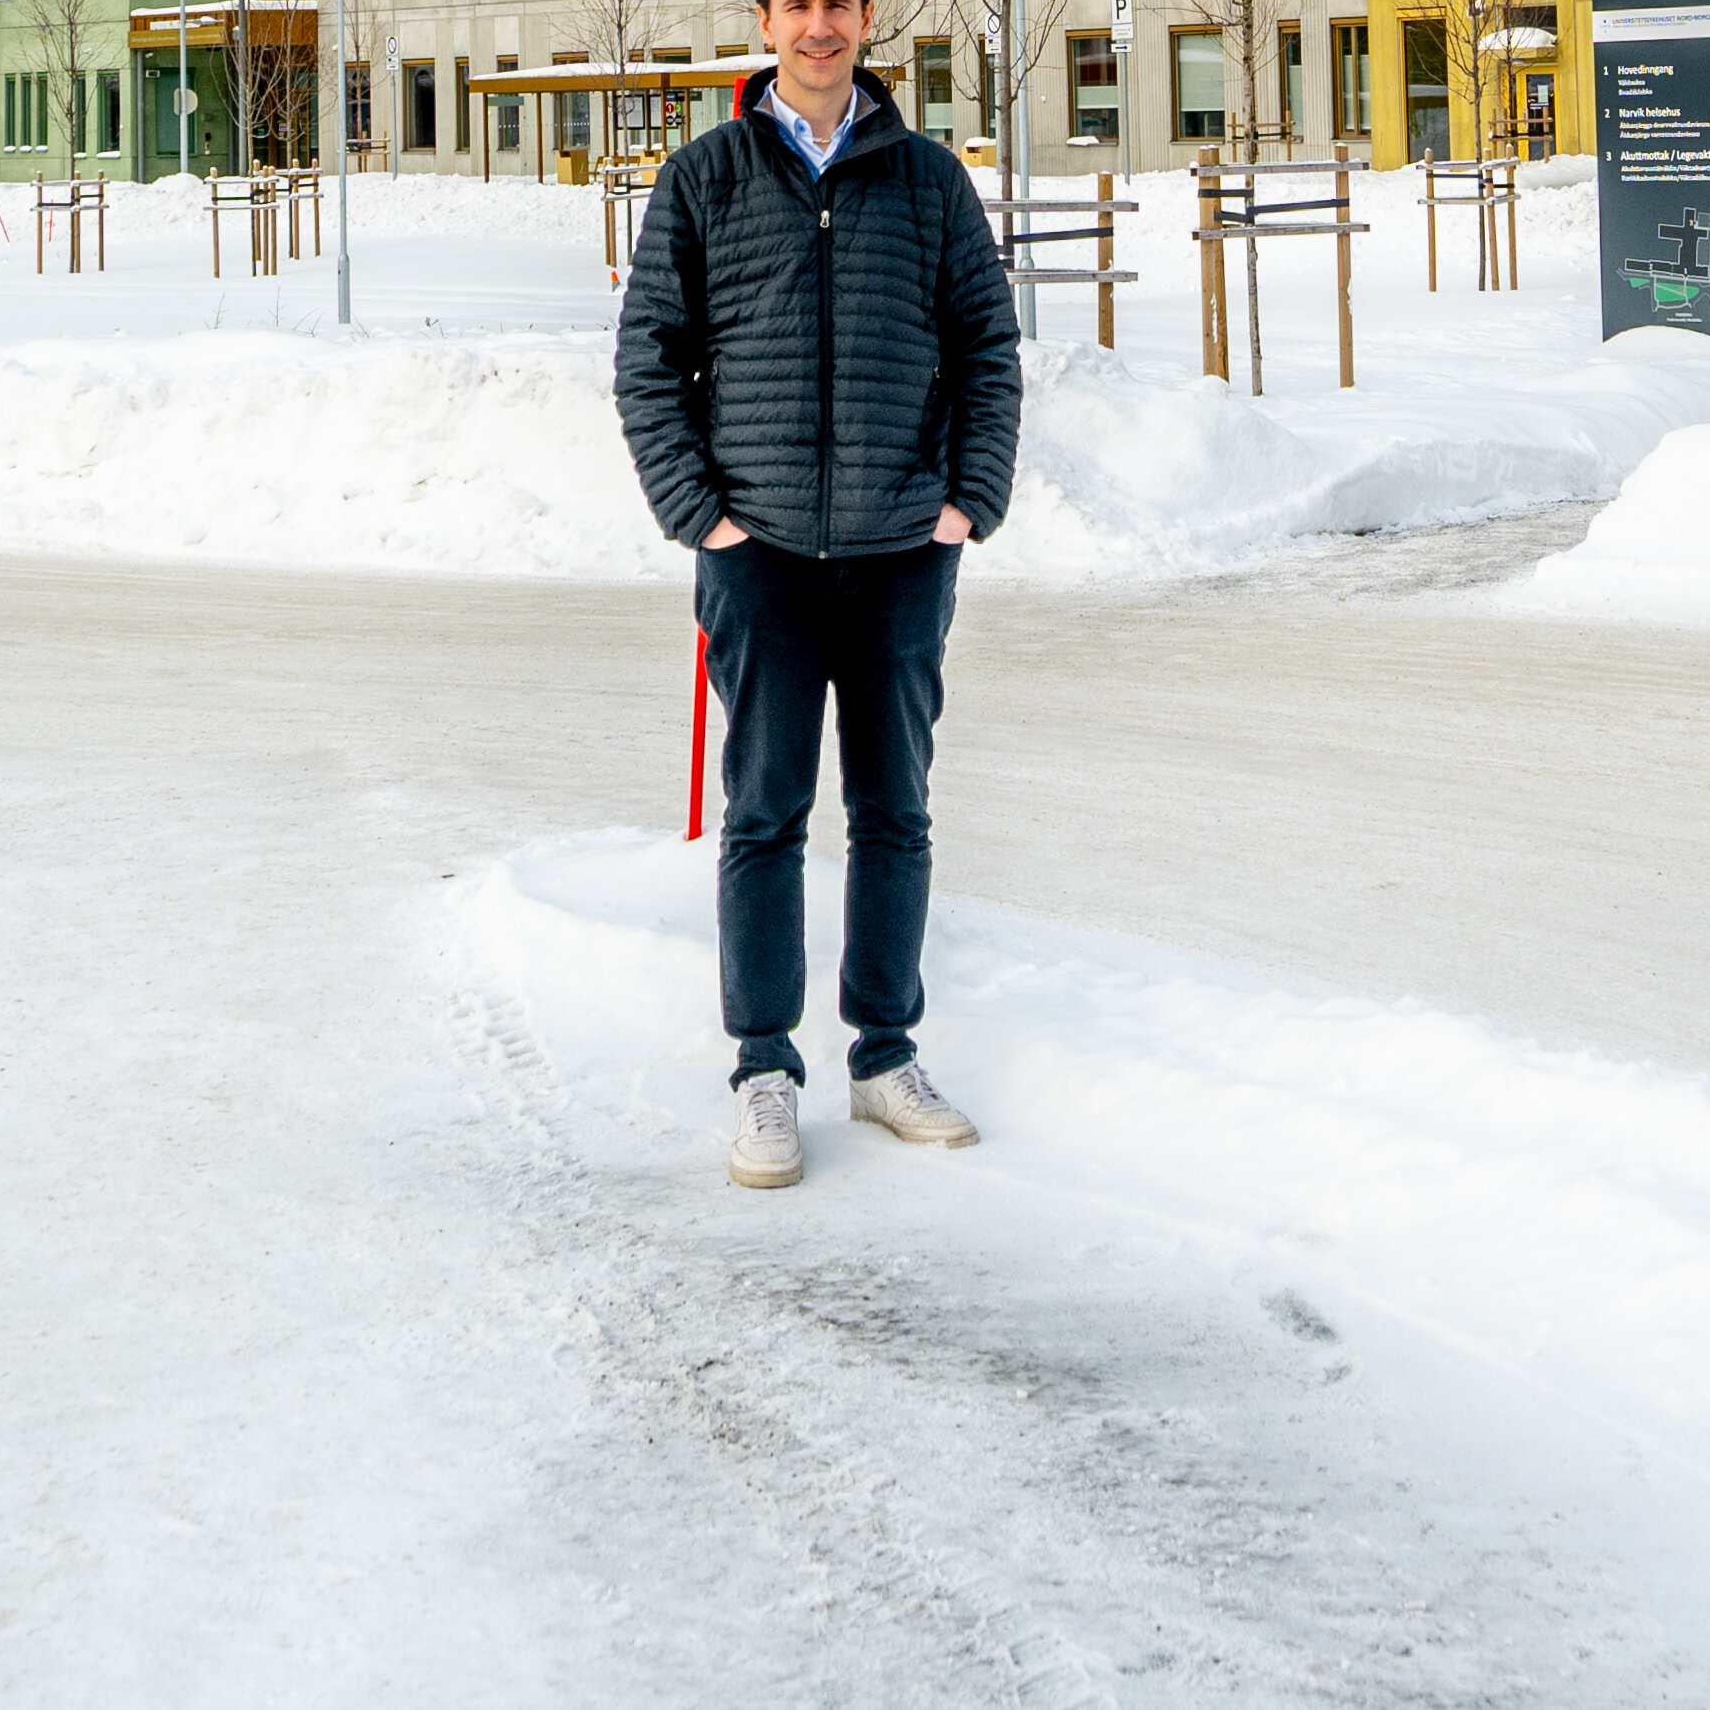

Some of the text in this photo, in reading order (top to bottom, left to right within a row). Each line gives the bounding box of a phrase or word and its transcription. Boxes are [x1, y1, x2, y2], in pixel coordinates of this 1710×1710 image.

[1603, 65, 1674, 76] 1 Hovedinngang
[1604, 107, 1681, 119] 2 Narvik helsehus
[1605, 151, 1612, 161] 3
[1620, 149, 1670, 161] Akuttmottak
